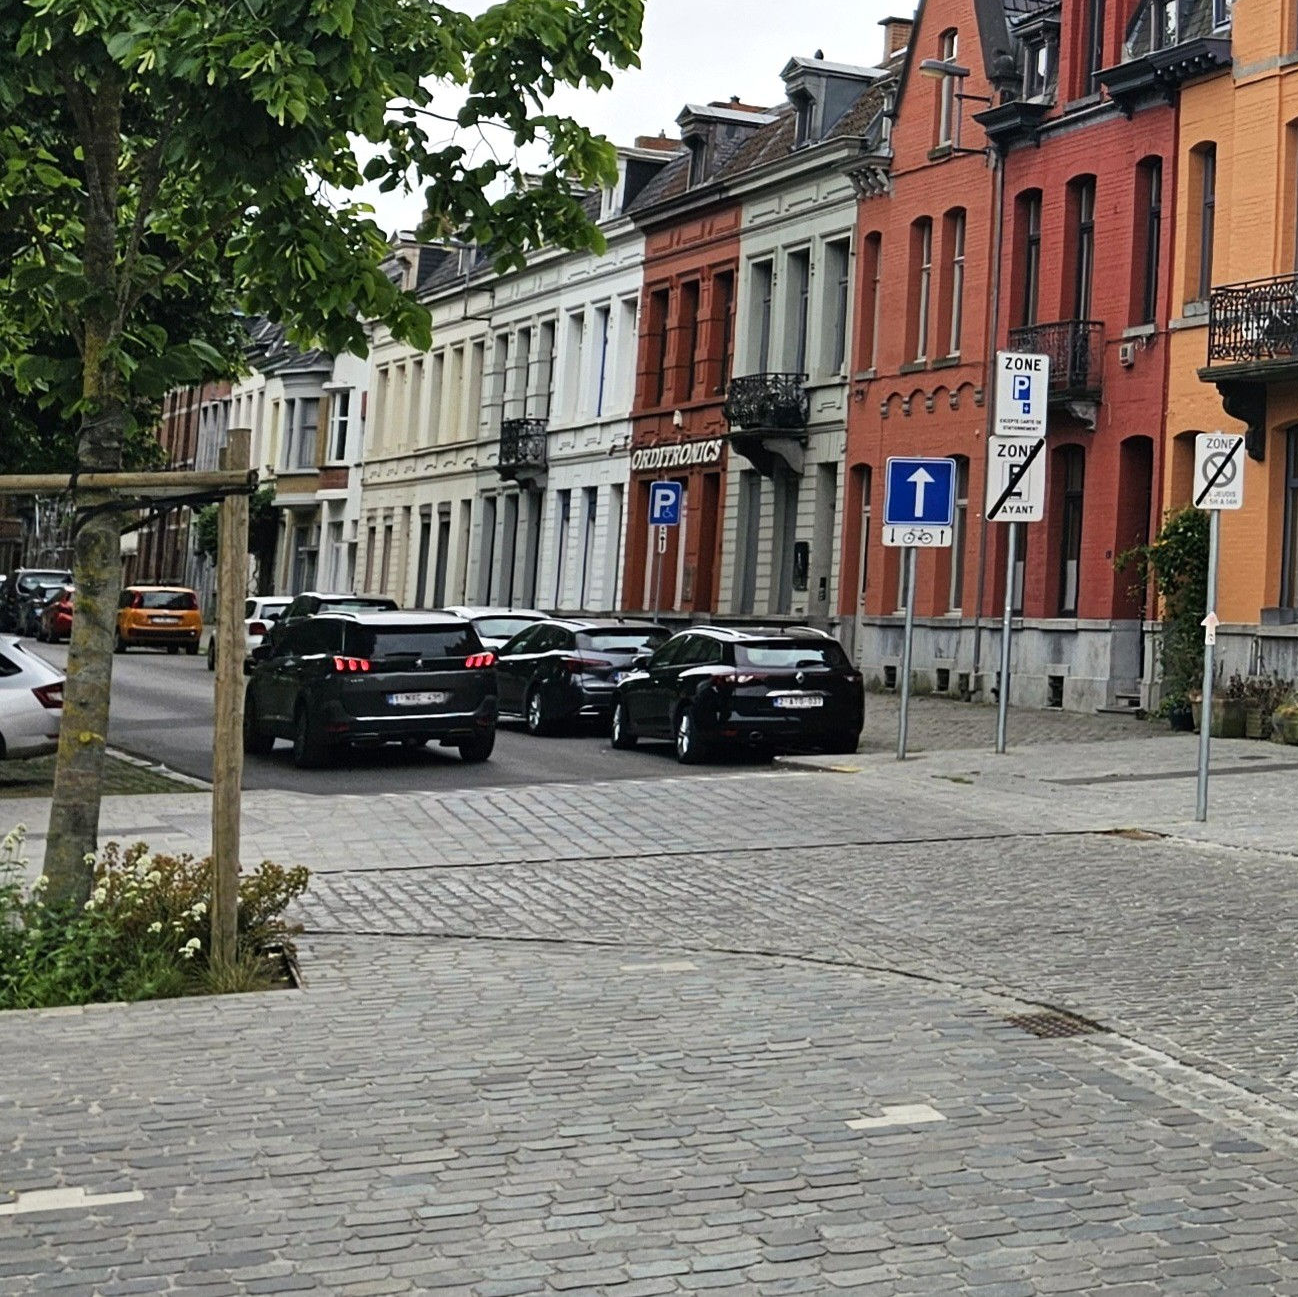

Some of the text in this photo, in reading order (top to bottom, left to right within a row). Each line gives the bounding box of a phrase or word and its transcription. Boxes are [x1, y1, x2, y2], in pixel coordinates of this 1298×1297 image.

[1005, 357, 1042, 371] ZONE
[1014, 376, 1030, 399] P
[632, 440, 722, 470] ORDITRONICS
[1206, 438, 1235, 449] ZONE
[653, 489, 676, 518] P
